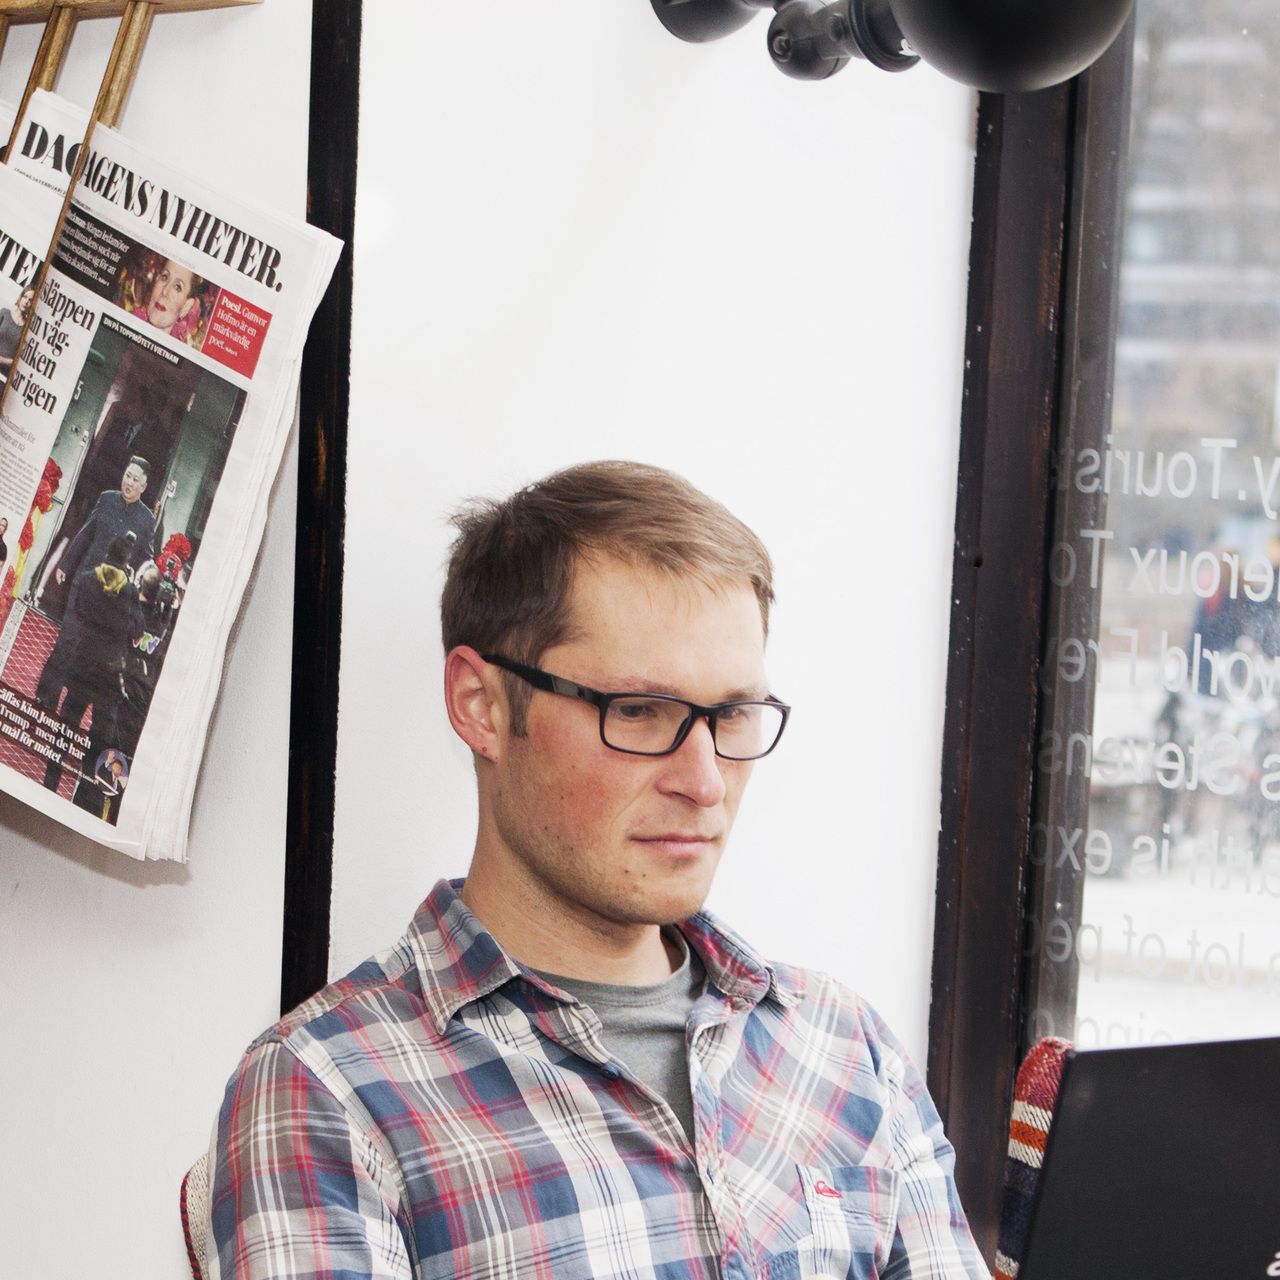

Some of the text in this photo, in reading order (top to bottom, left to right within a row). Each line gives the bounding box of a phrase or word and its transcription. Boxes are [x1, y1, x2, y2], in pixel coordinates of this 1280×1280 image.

[78, 146, 283, 293] AGENS NYHETER.
[221, 295, 268, 327] Poesi. Gunvor
[42, 322, 70, 357] väg-
[119, 326, 152, 350] TOPPMÖTET
[154, 346, 180, 365] VIETNAM
[212, 322, 251, 350] märkvärdig
[247, 325, 257, 337] en
[23, 374, 58, 414] igen
[0, 703, 31, 730] Trump
[35, 726, 57, 746] men
[56, 734, 70, 752] de
[68, 743, 86, 762] har
[1, 720, 21, 739] mål
[19, 729, 35, 748] för
[20, 698, 43, 719] Kim
[37, 711, 75, 740] Jong-Un
[74, 732, 92, 750] och
